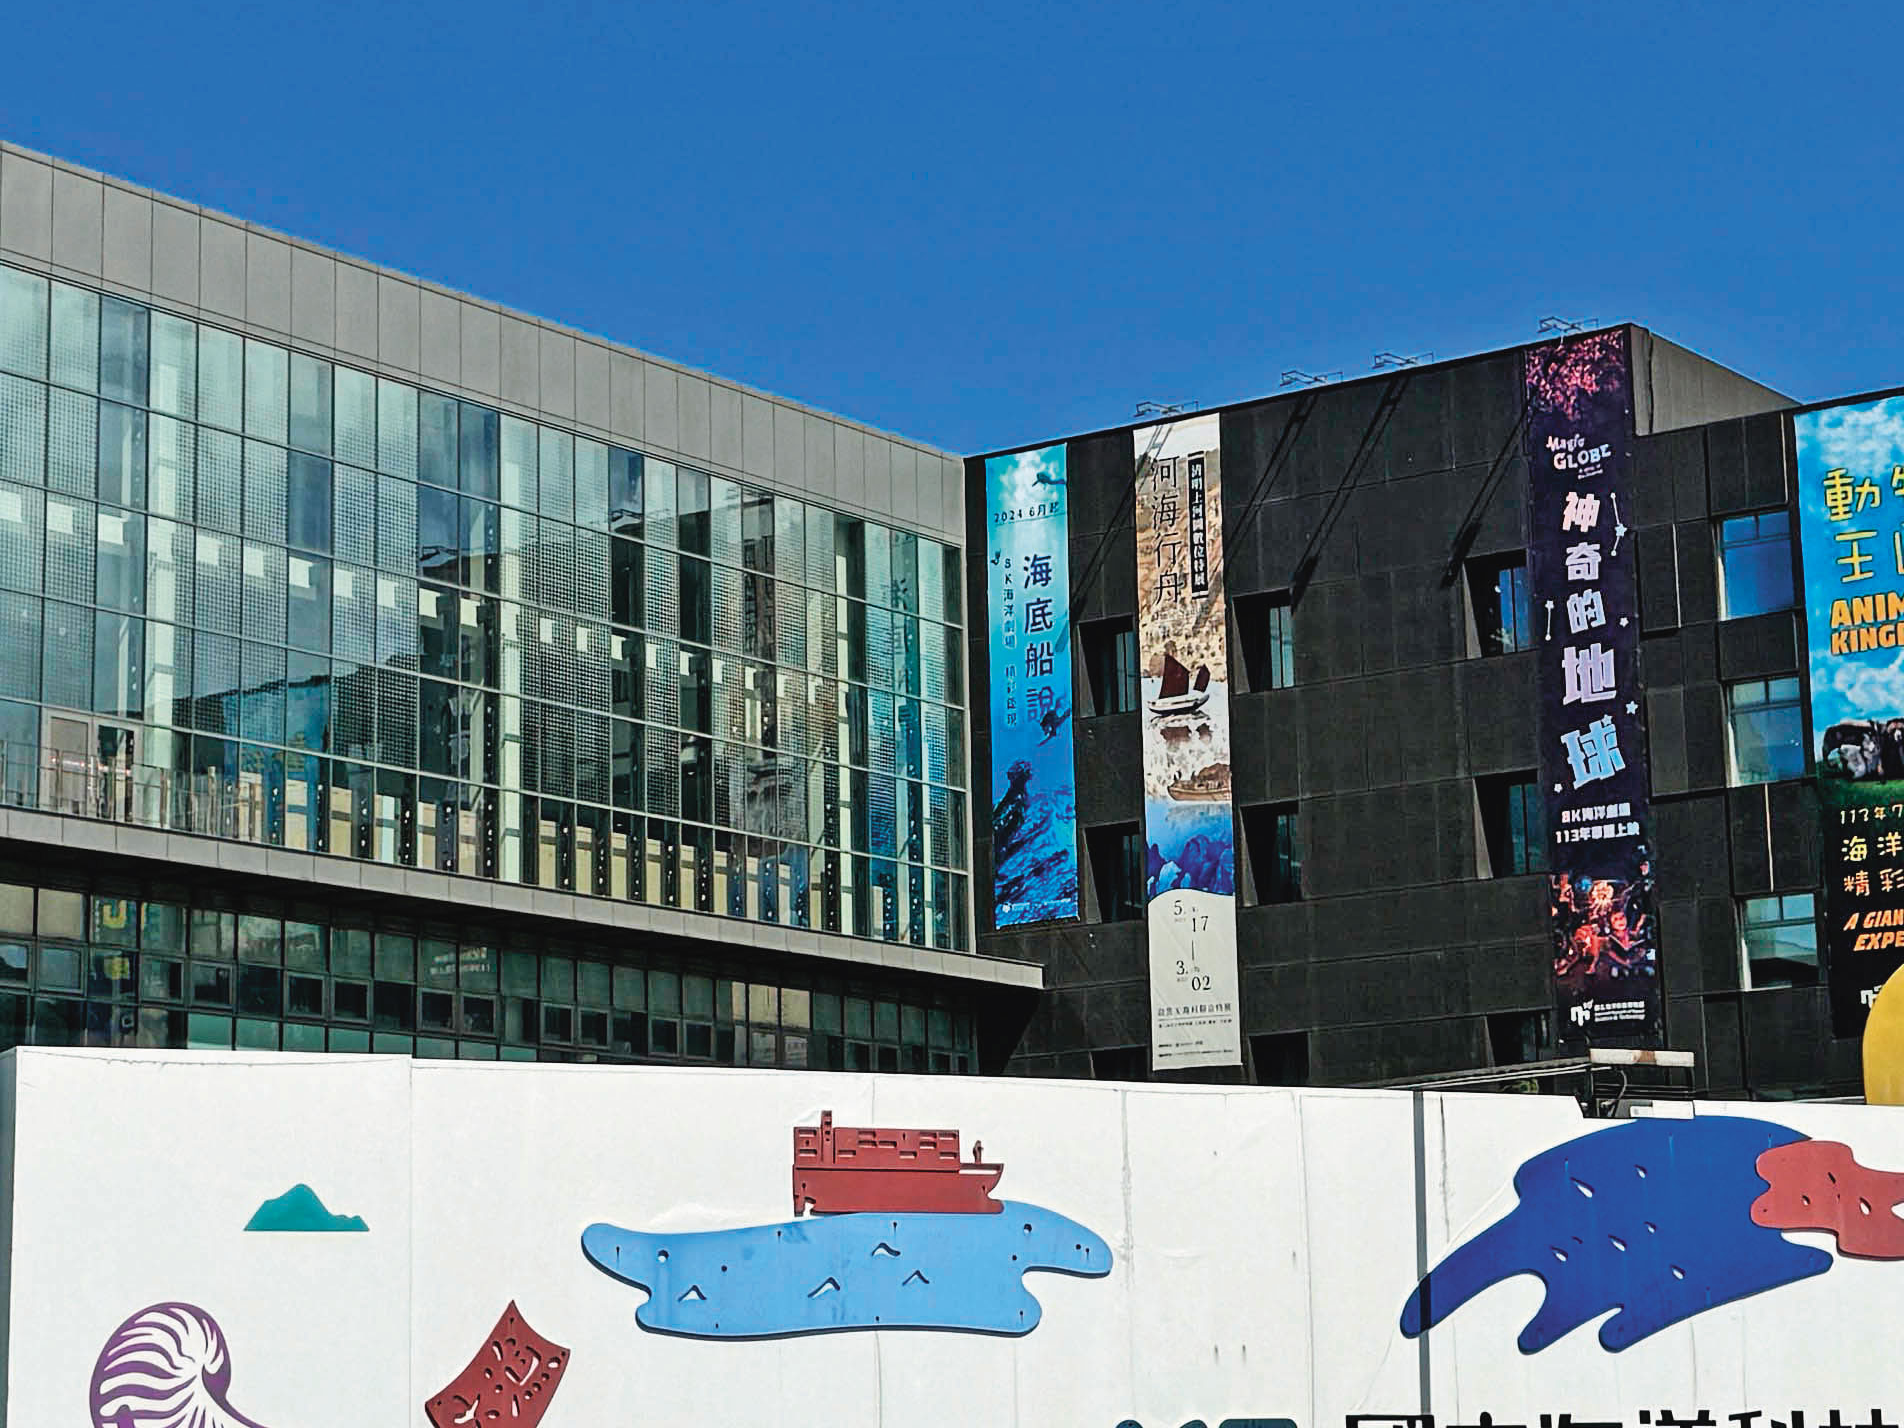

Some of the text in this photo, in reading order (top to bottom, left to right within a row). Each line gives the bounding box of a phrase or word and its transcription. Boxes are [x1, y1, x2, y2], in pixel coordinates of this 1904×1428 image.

[1545, 433, 1585, 452] Magic
[1553, 443, 1612, 470] GLOBE
[993, 509, 1022, 523] 2024
[1151, 455, 1184, 605] 河海行舟
[1022, 553, 1054, 724] 海底船說
[1560, 491, 1626, 790] 神奇的地球
[1192, 915, 1209, 933] 17
[1843, 912, 1860, 931] A
[1191, 975, 1213, 991] 02
